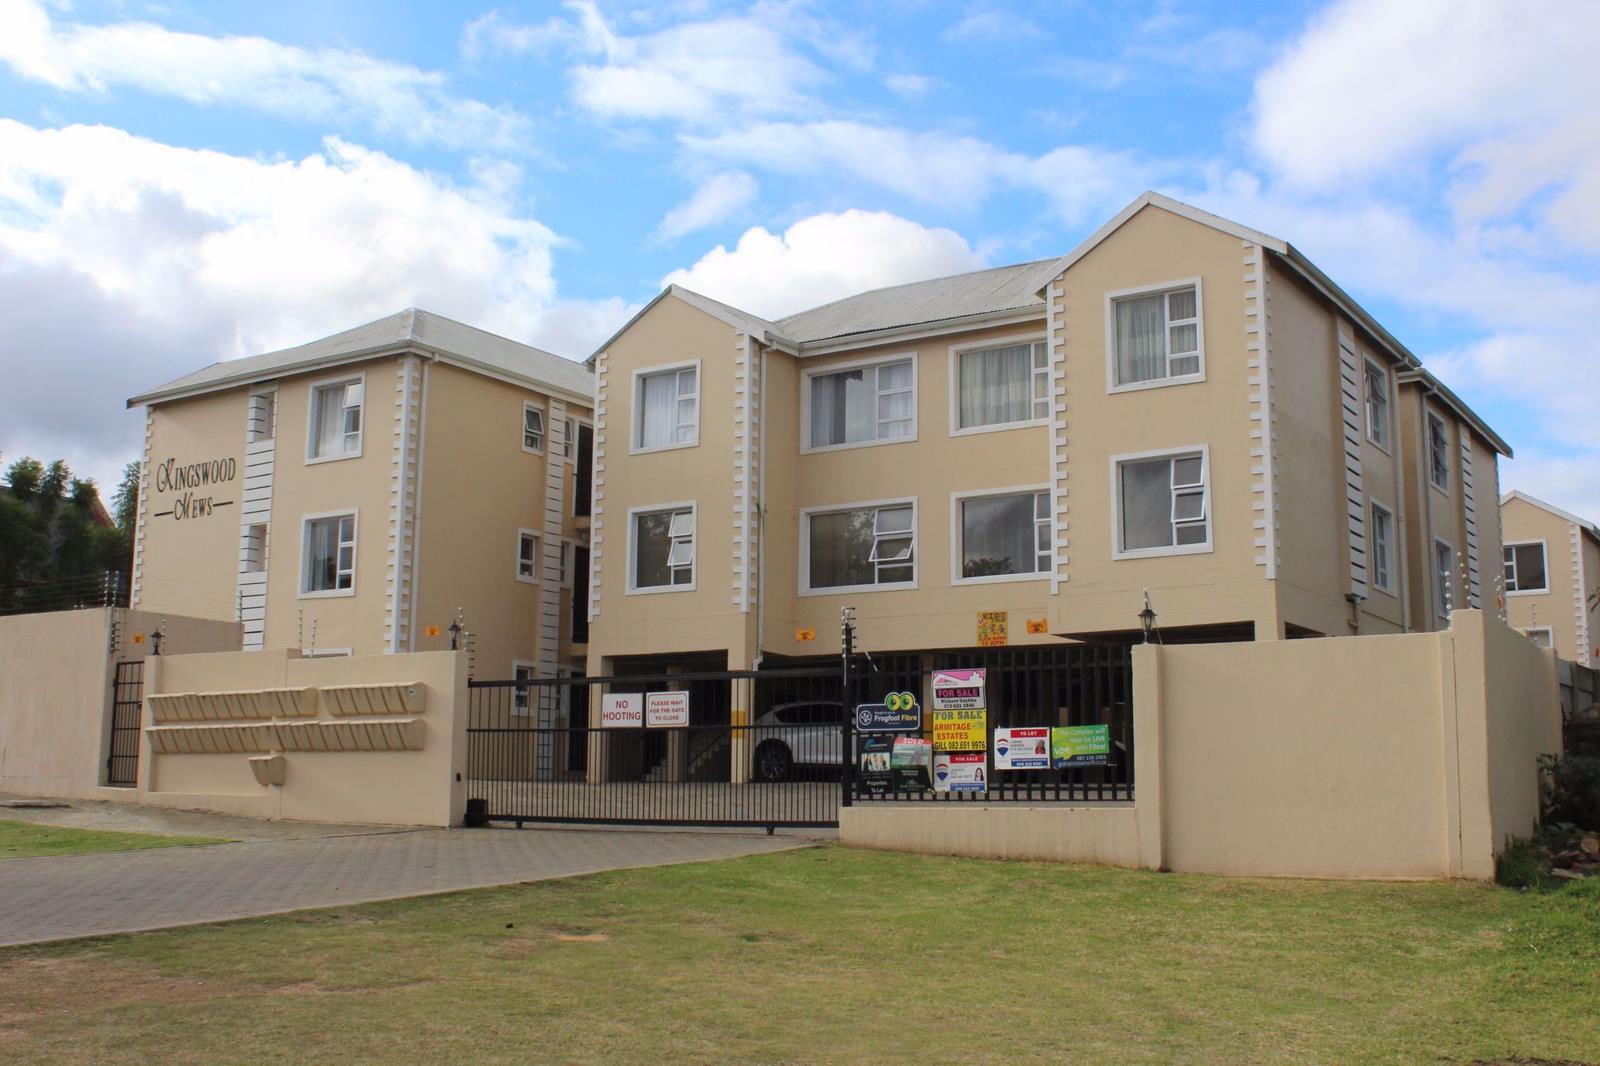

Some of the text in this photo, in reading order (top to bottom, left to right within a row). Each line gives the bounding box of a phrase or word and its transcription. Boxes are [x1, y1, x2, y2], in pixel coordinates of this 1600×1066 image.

[157, 457, 236, 493] KINGSWOOD
[174, 492, 213, 520] MEWS
[938, 688, 978, 698] FOR SALE
[616, 700, 628, 709] NO
[603, 711, 641, 721] HOOTING
[874, 714, 900, 723] Frogfoot
[935, 710, 983, 720] FOR SALE
[935, 722, 971, 731] ARMITAGE
[937, 732, 969, 740] ESTATES
[935, 741, 947, 750] GILL
